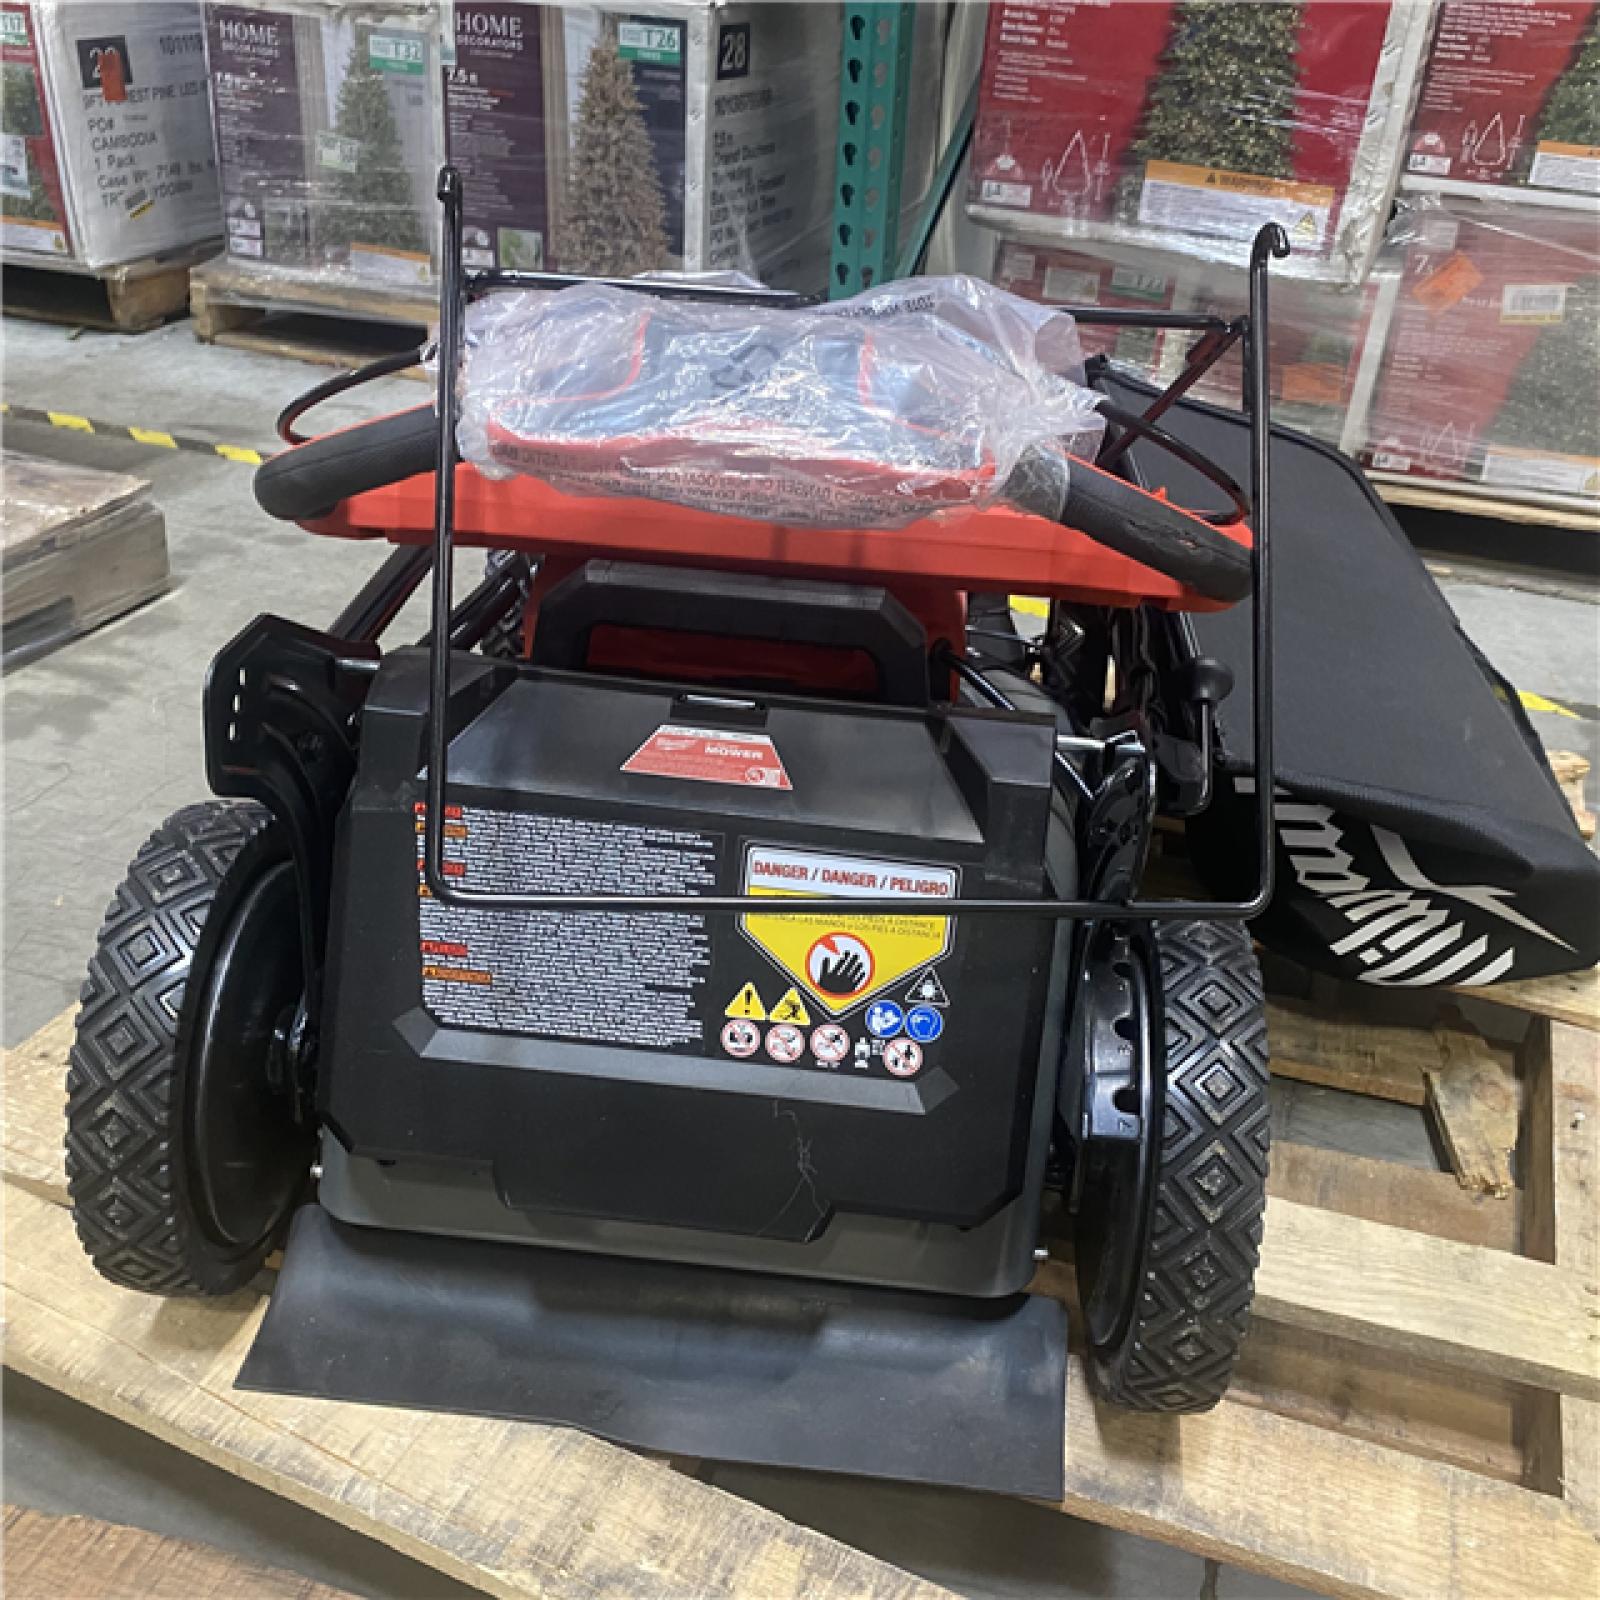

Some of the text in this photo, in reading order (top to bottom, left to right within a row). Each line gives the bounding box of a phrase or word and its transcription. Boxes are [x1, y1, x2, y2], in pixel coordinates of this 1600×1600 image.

[220, 19, 279, 46] HOME
[456, 10, 522, 38] HOME
[722, 31, 746, 71] 28
[92, 130, 158, 152] CAMBODIA
[753, 860, 949, 897] DANGER / DANGER / PELIGRO
